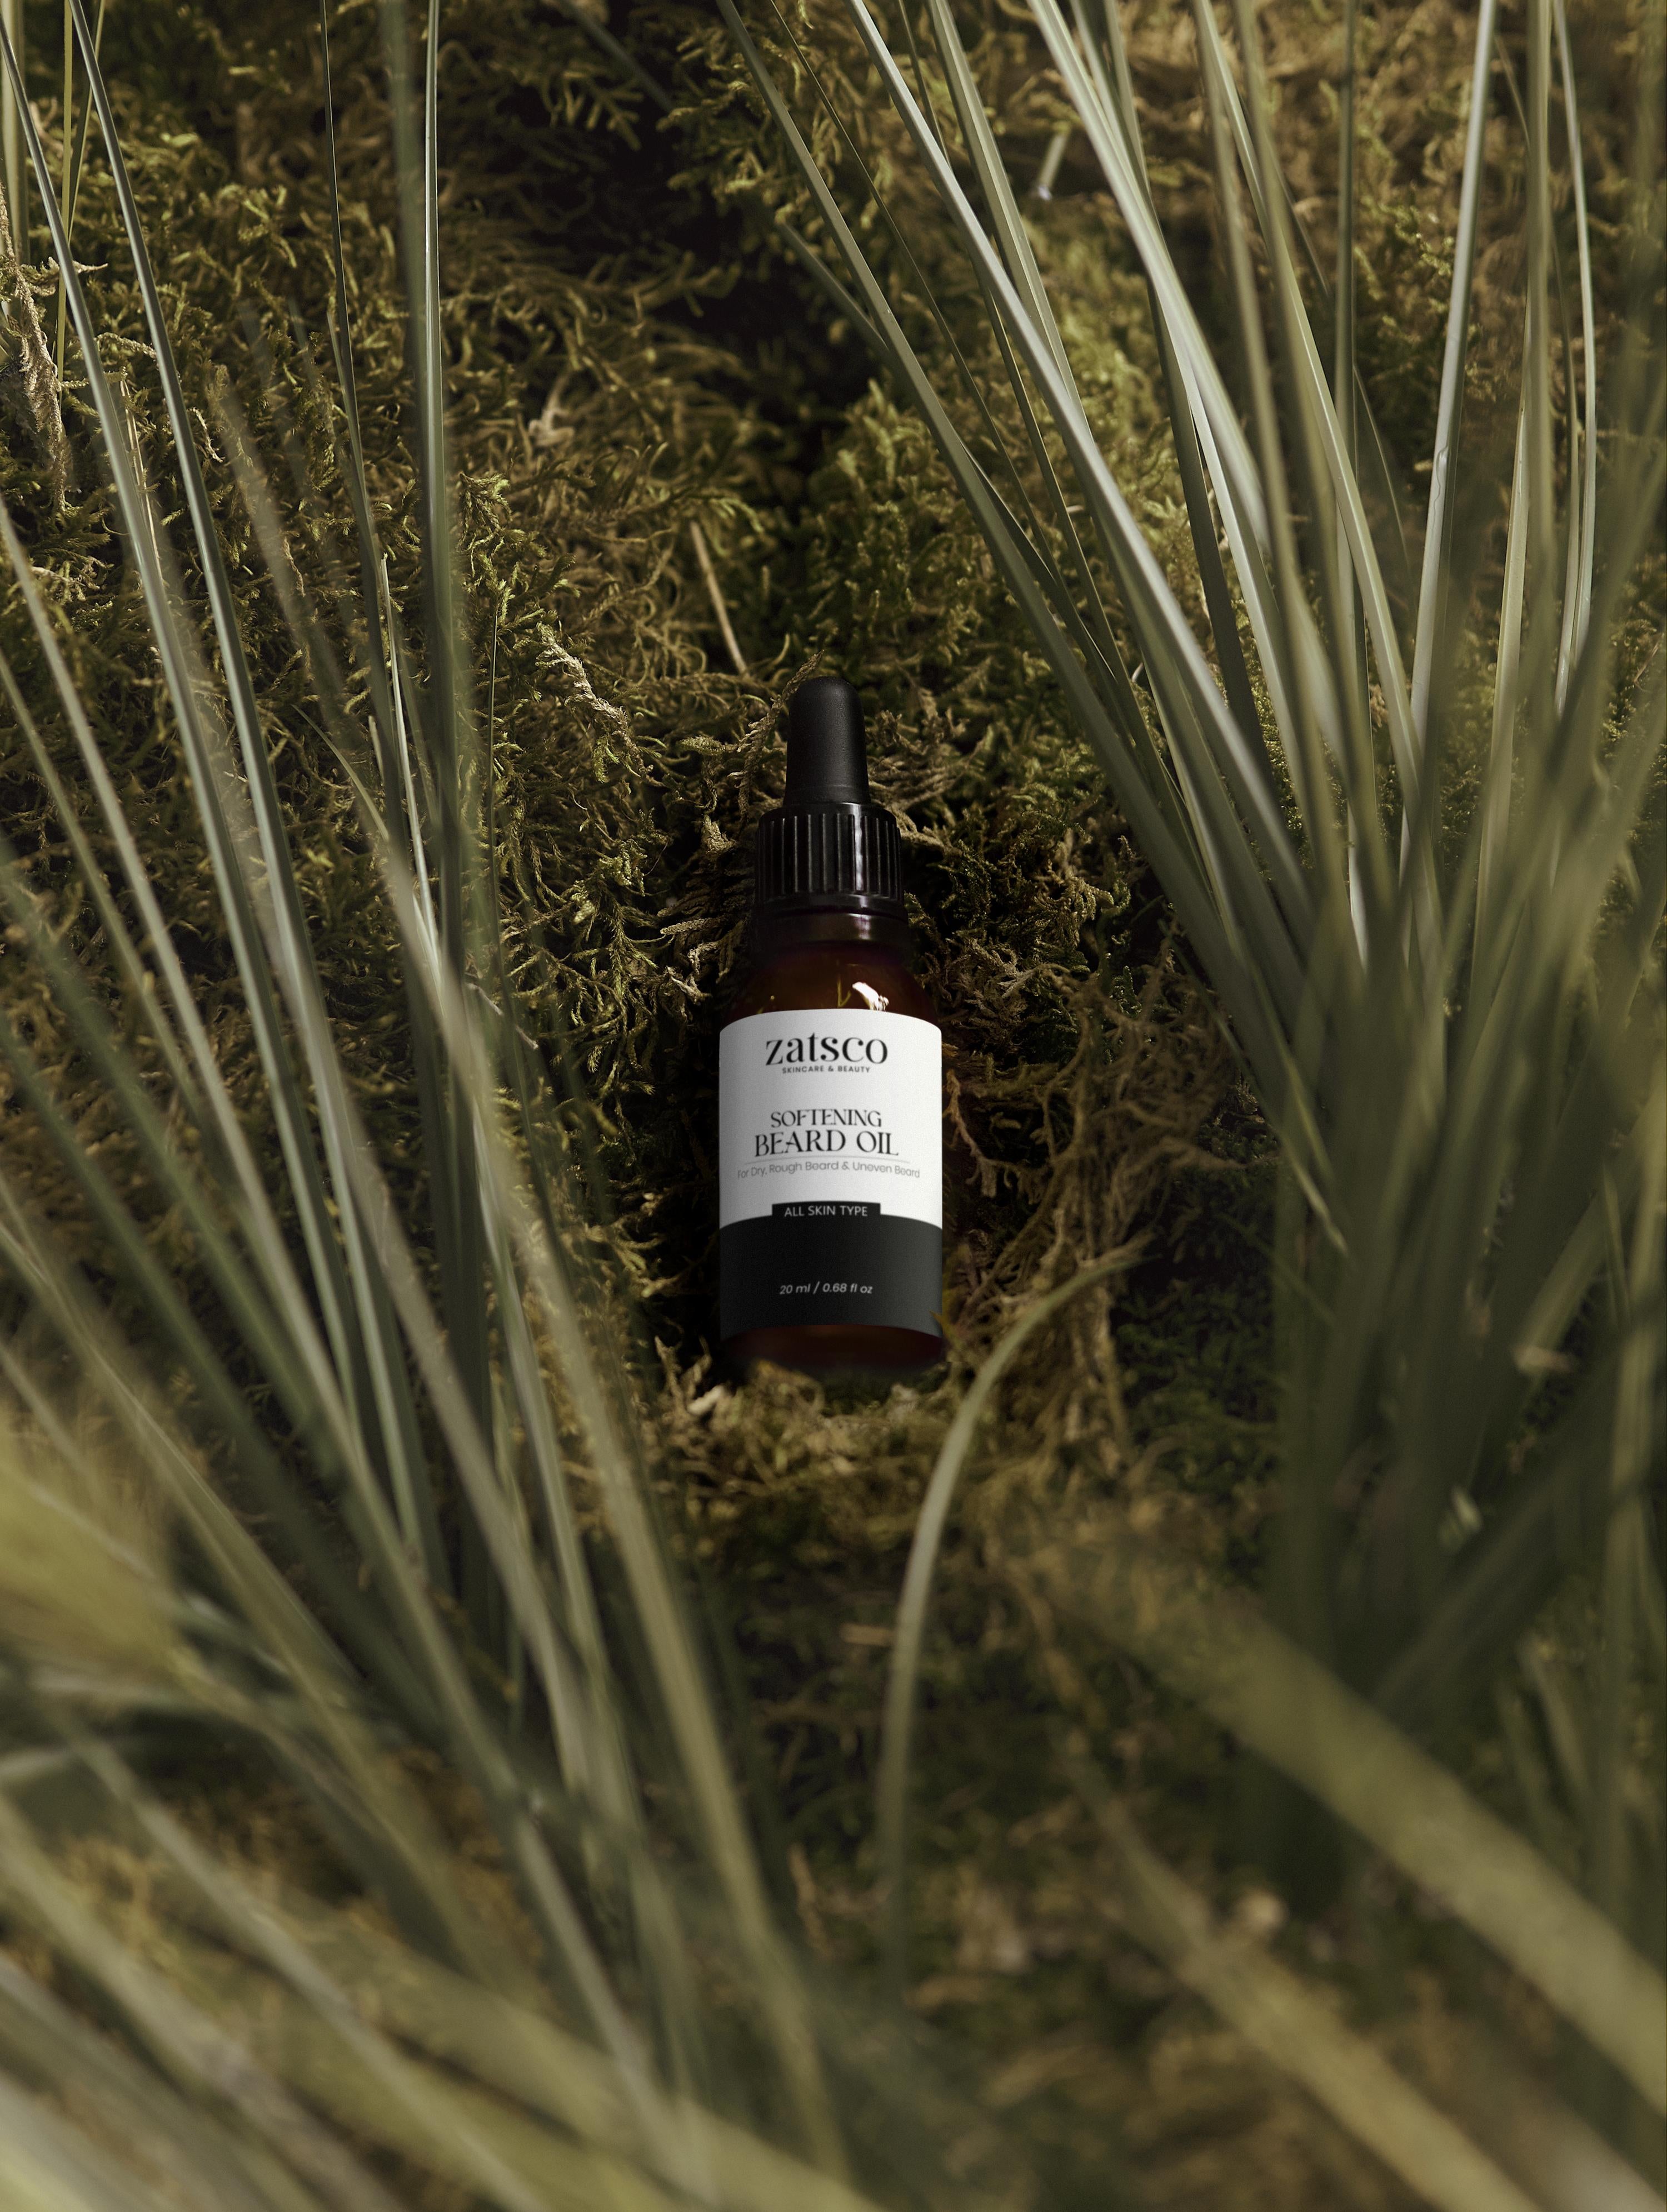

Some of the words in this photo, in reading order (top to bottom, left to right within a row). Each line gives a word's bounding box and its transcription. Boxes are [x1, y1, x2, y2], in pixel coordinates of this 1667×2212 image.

[766, 1032, 888, 1065] zatsco
[782, 1065, 824, 1074] SKINCARE
[770, 1109, 882, 1128] SOFTENING
[754, 1129, 846, 1157] BEARD
[856, 1130, 899, 1156] OIL
[737, 1170, 748, 1179] For
[751, 1167, 767, 1177] Dry,
[769, 1162, 802, 1175] Rough
[805, 1161, 839, 1171] Beard
[841, 1162, 850, 1170] &
[852, 1162, 892, 1174] Uneven
[895, 1165, 920, 1178] Beard
[784, 1207, 804, 1217] ALL
[808, 1205, 836, 1216] SKIN
[840, 1205, 868, 1217] TYPE
[780, 1285, 793, 1294] 20
[796, 1283, 810, 1294] ml
[813, 1282, 820, 1295] /
[822, 1283, 847, 1293] 0.68
[850, 1283, 857, 1293] fl
